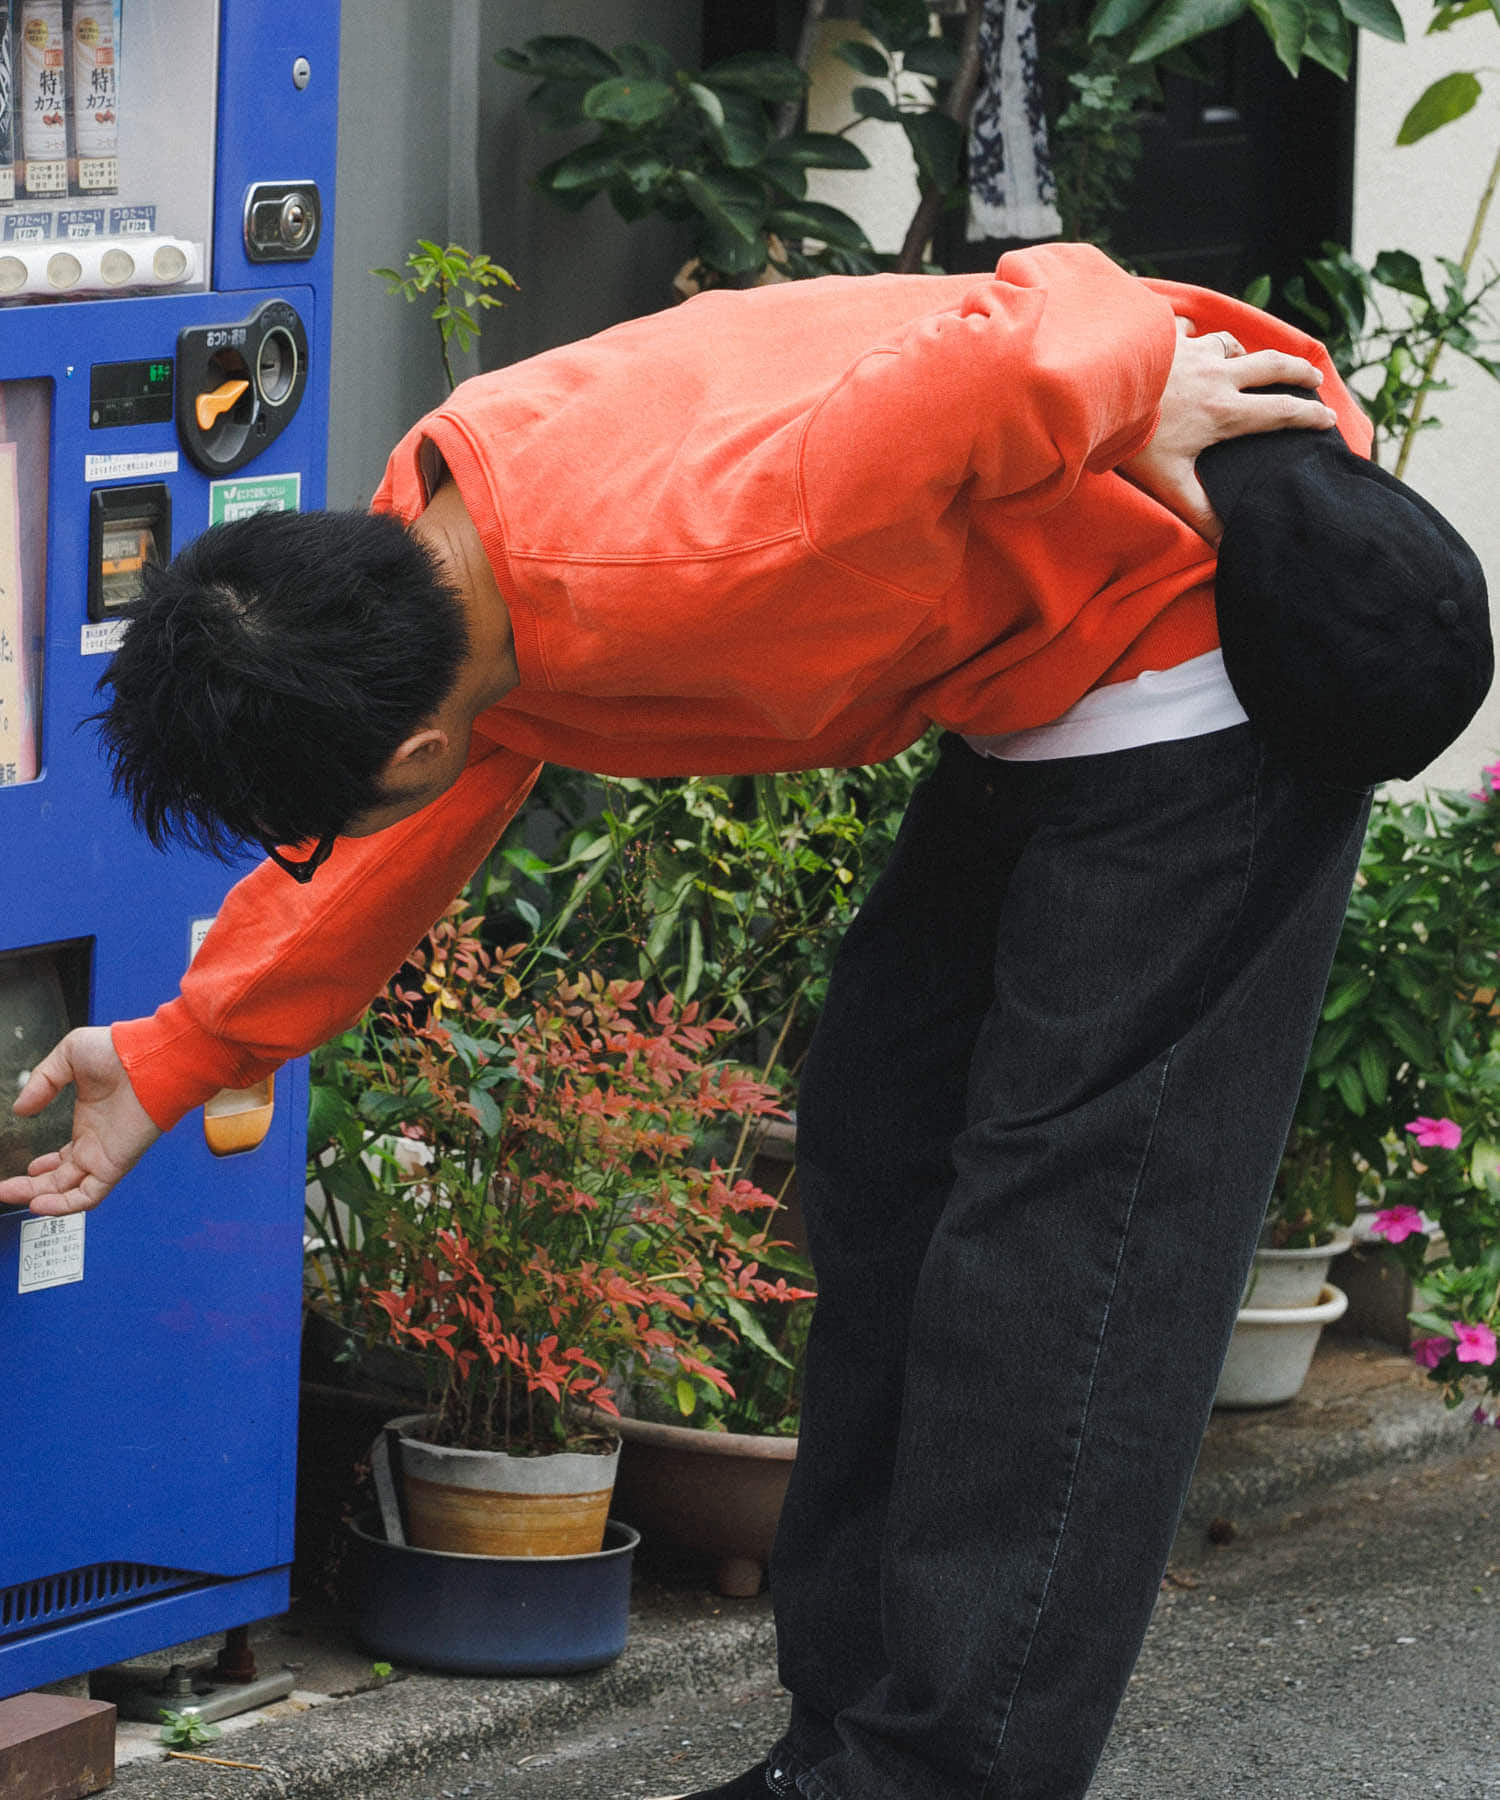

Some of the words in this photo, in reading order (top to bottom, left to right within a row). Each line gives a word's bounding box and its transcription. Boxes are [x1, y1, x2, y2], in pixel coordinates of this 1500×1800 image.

[34, 95, 64, 111] カフェ
[86, 93, 116, 109] カフェ
